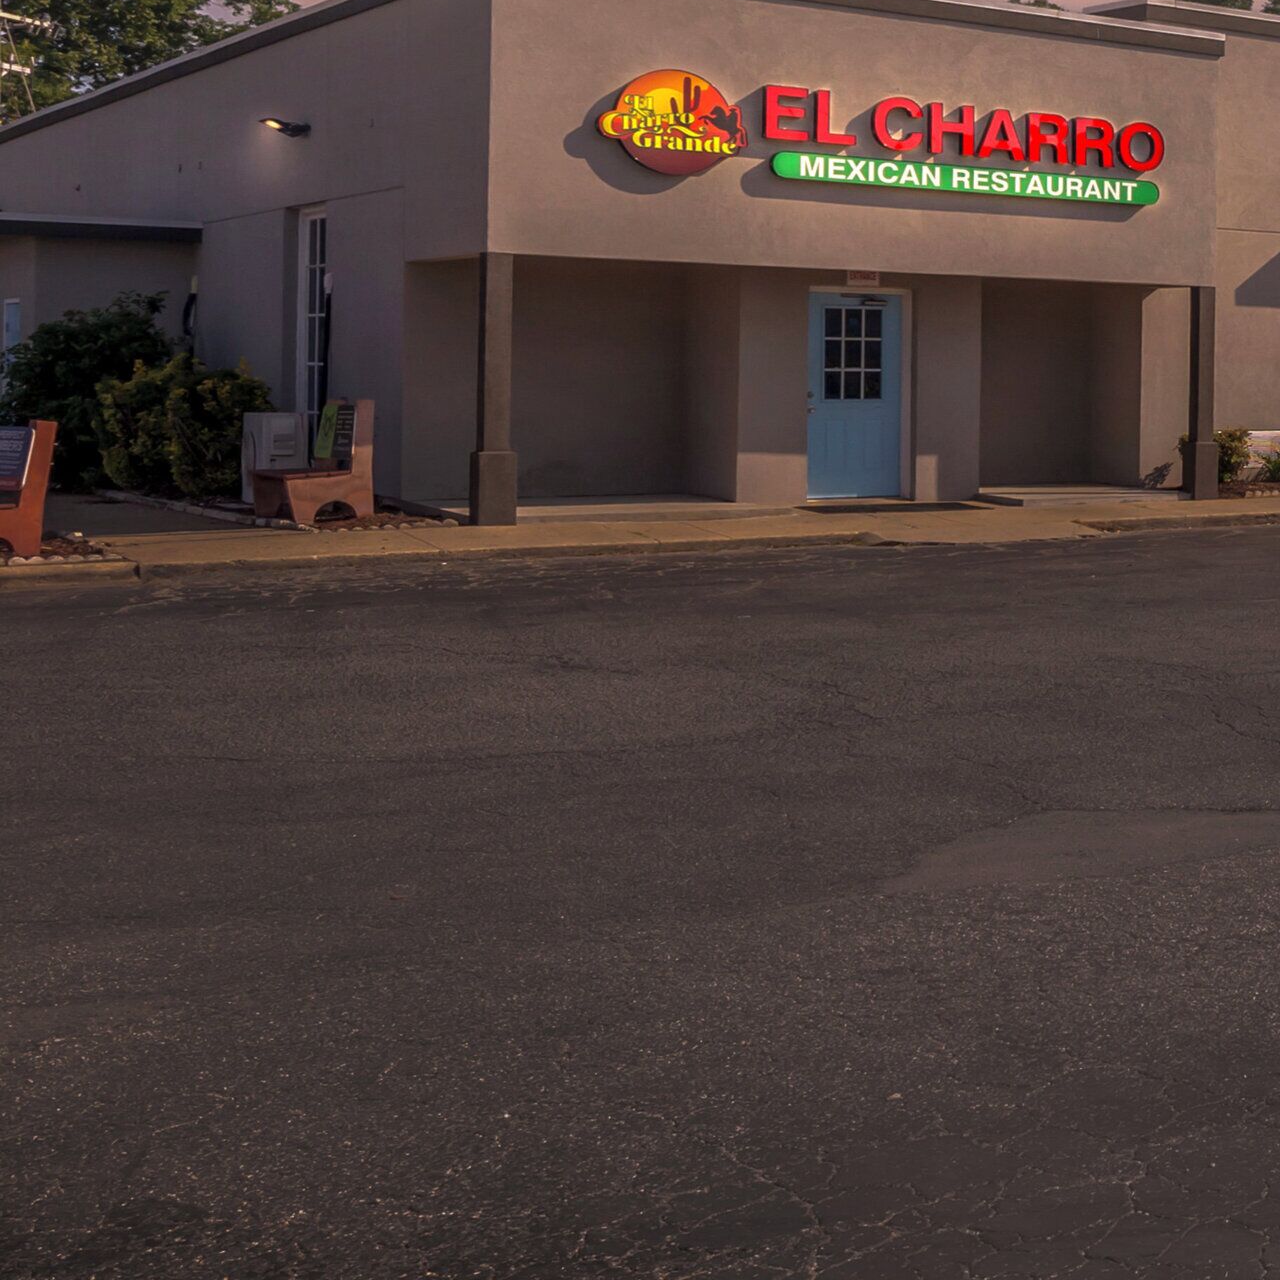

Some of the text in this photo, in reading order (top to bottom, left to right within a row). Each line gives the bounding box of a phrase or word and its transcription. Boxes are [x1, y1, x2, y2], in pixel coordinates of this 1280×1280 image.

[602, 111, 696, 136] Charro
[632, 128, 737, 155] Grande
[761, 84, 1164, 172] EL CHARRO
[799, 155, 1137, 201] MEXICAN RESTAURANT
